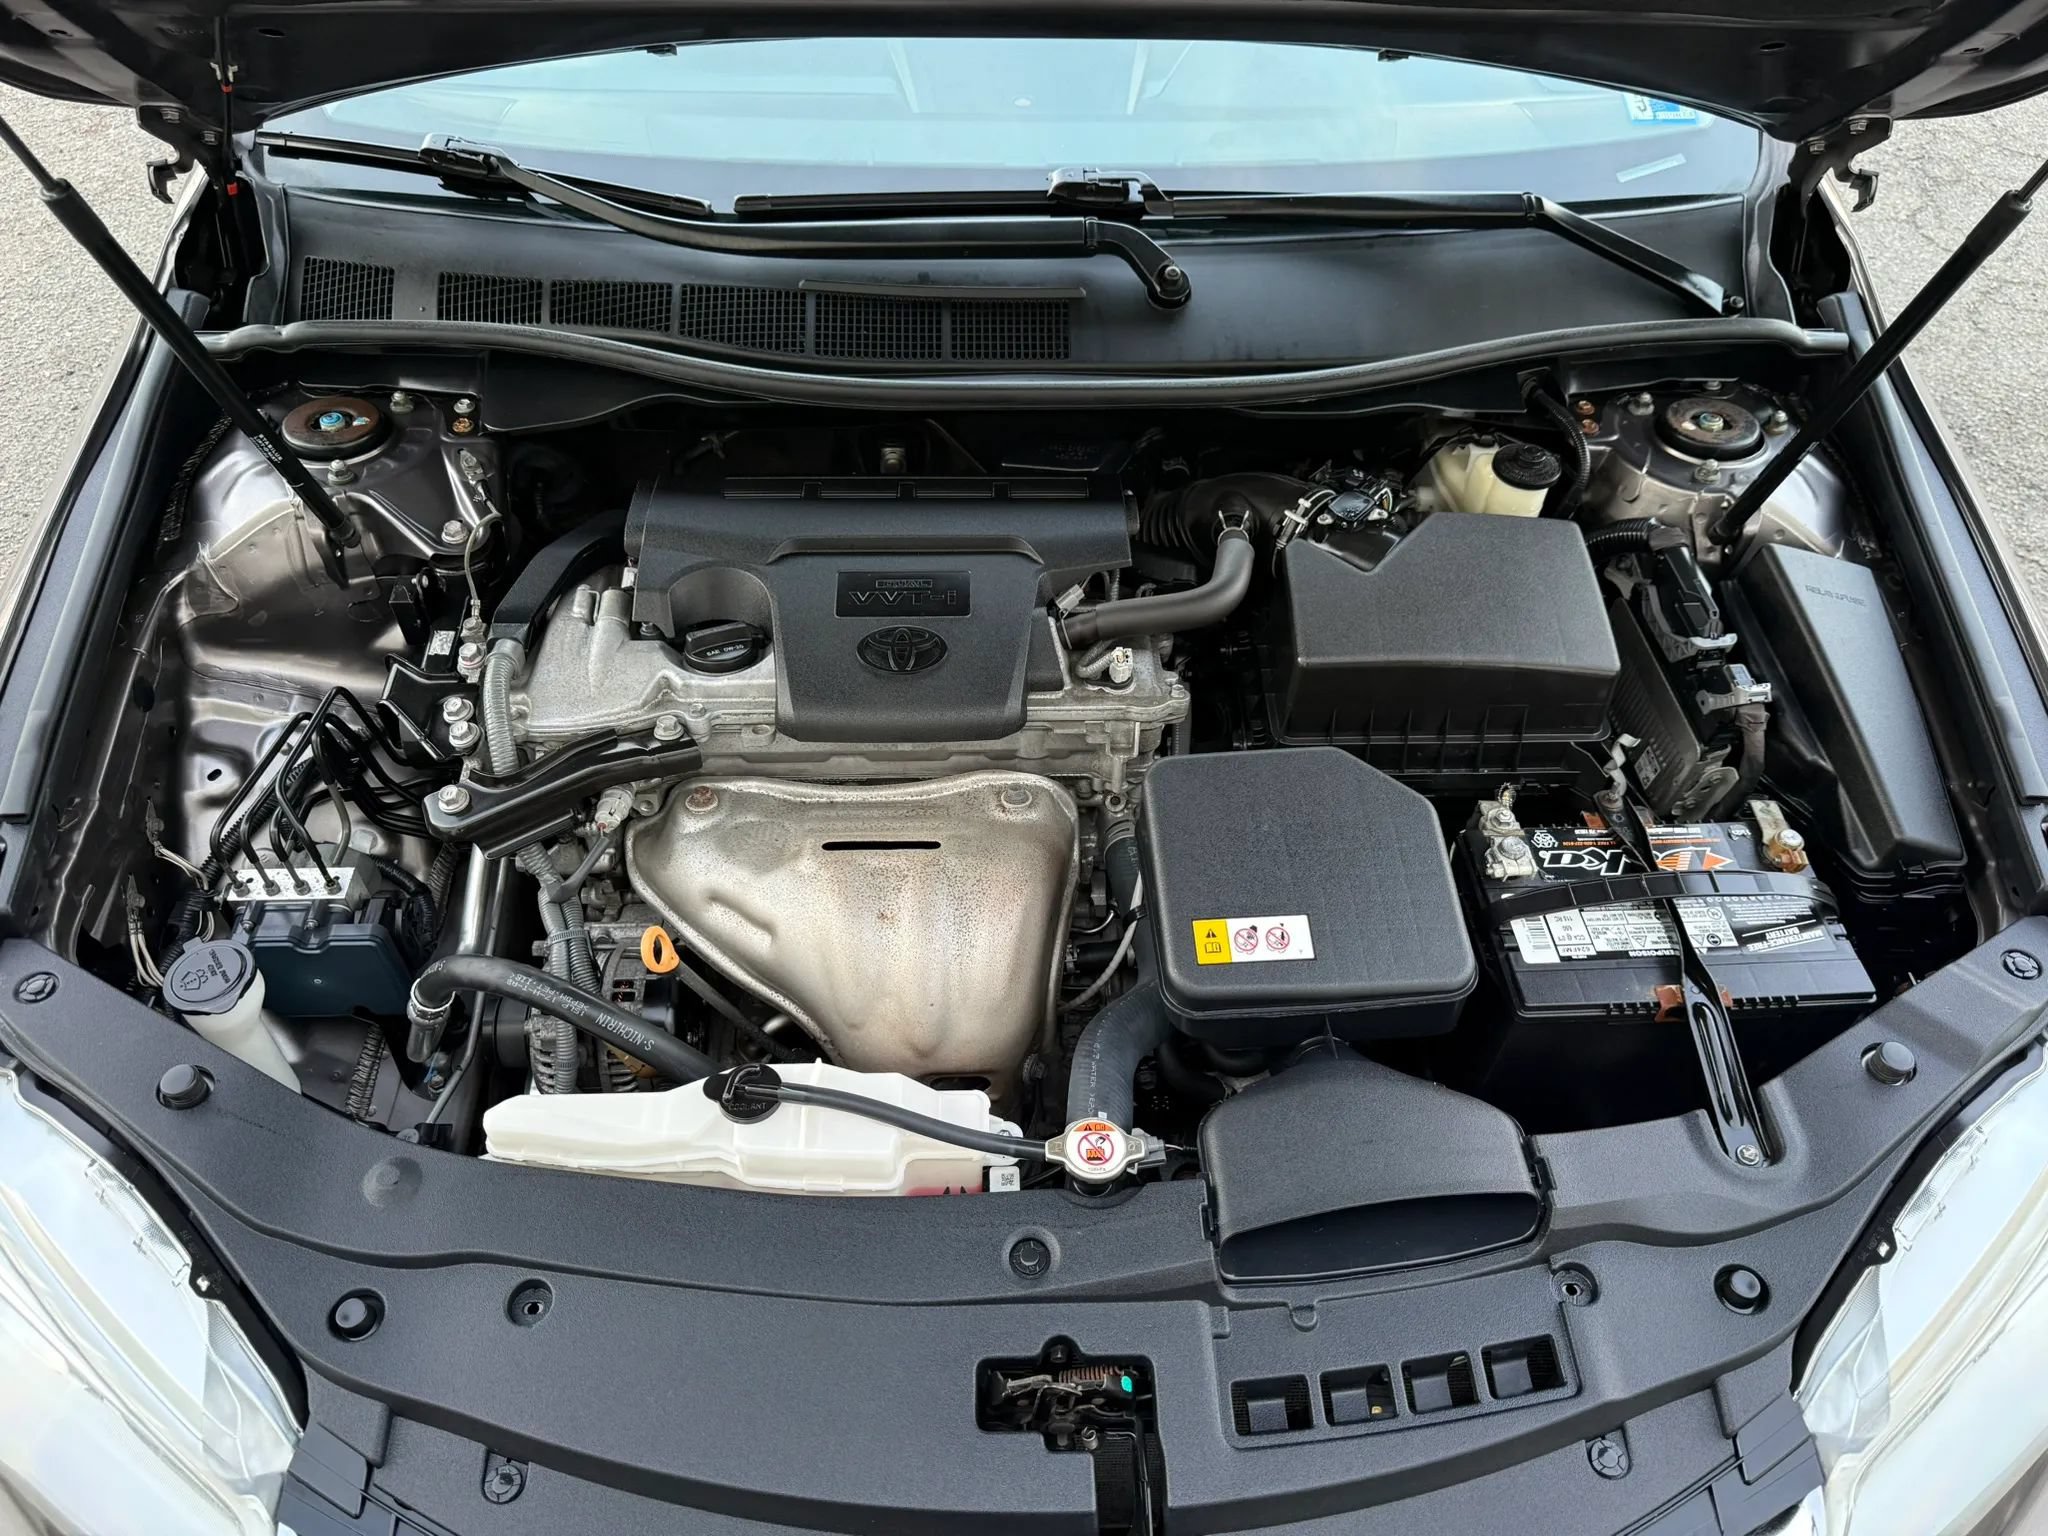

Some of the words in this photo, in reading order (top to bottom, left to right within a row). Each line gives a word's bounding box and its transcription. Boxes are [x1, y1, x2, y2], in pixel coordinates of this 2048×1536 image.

[849, 590, 957, 606] VVT-i
[1746, 930, 1824, 951] MAINTENANCE-FREE
[1765, 927, 1800, 940] BATTERY
